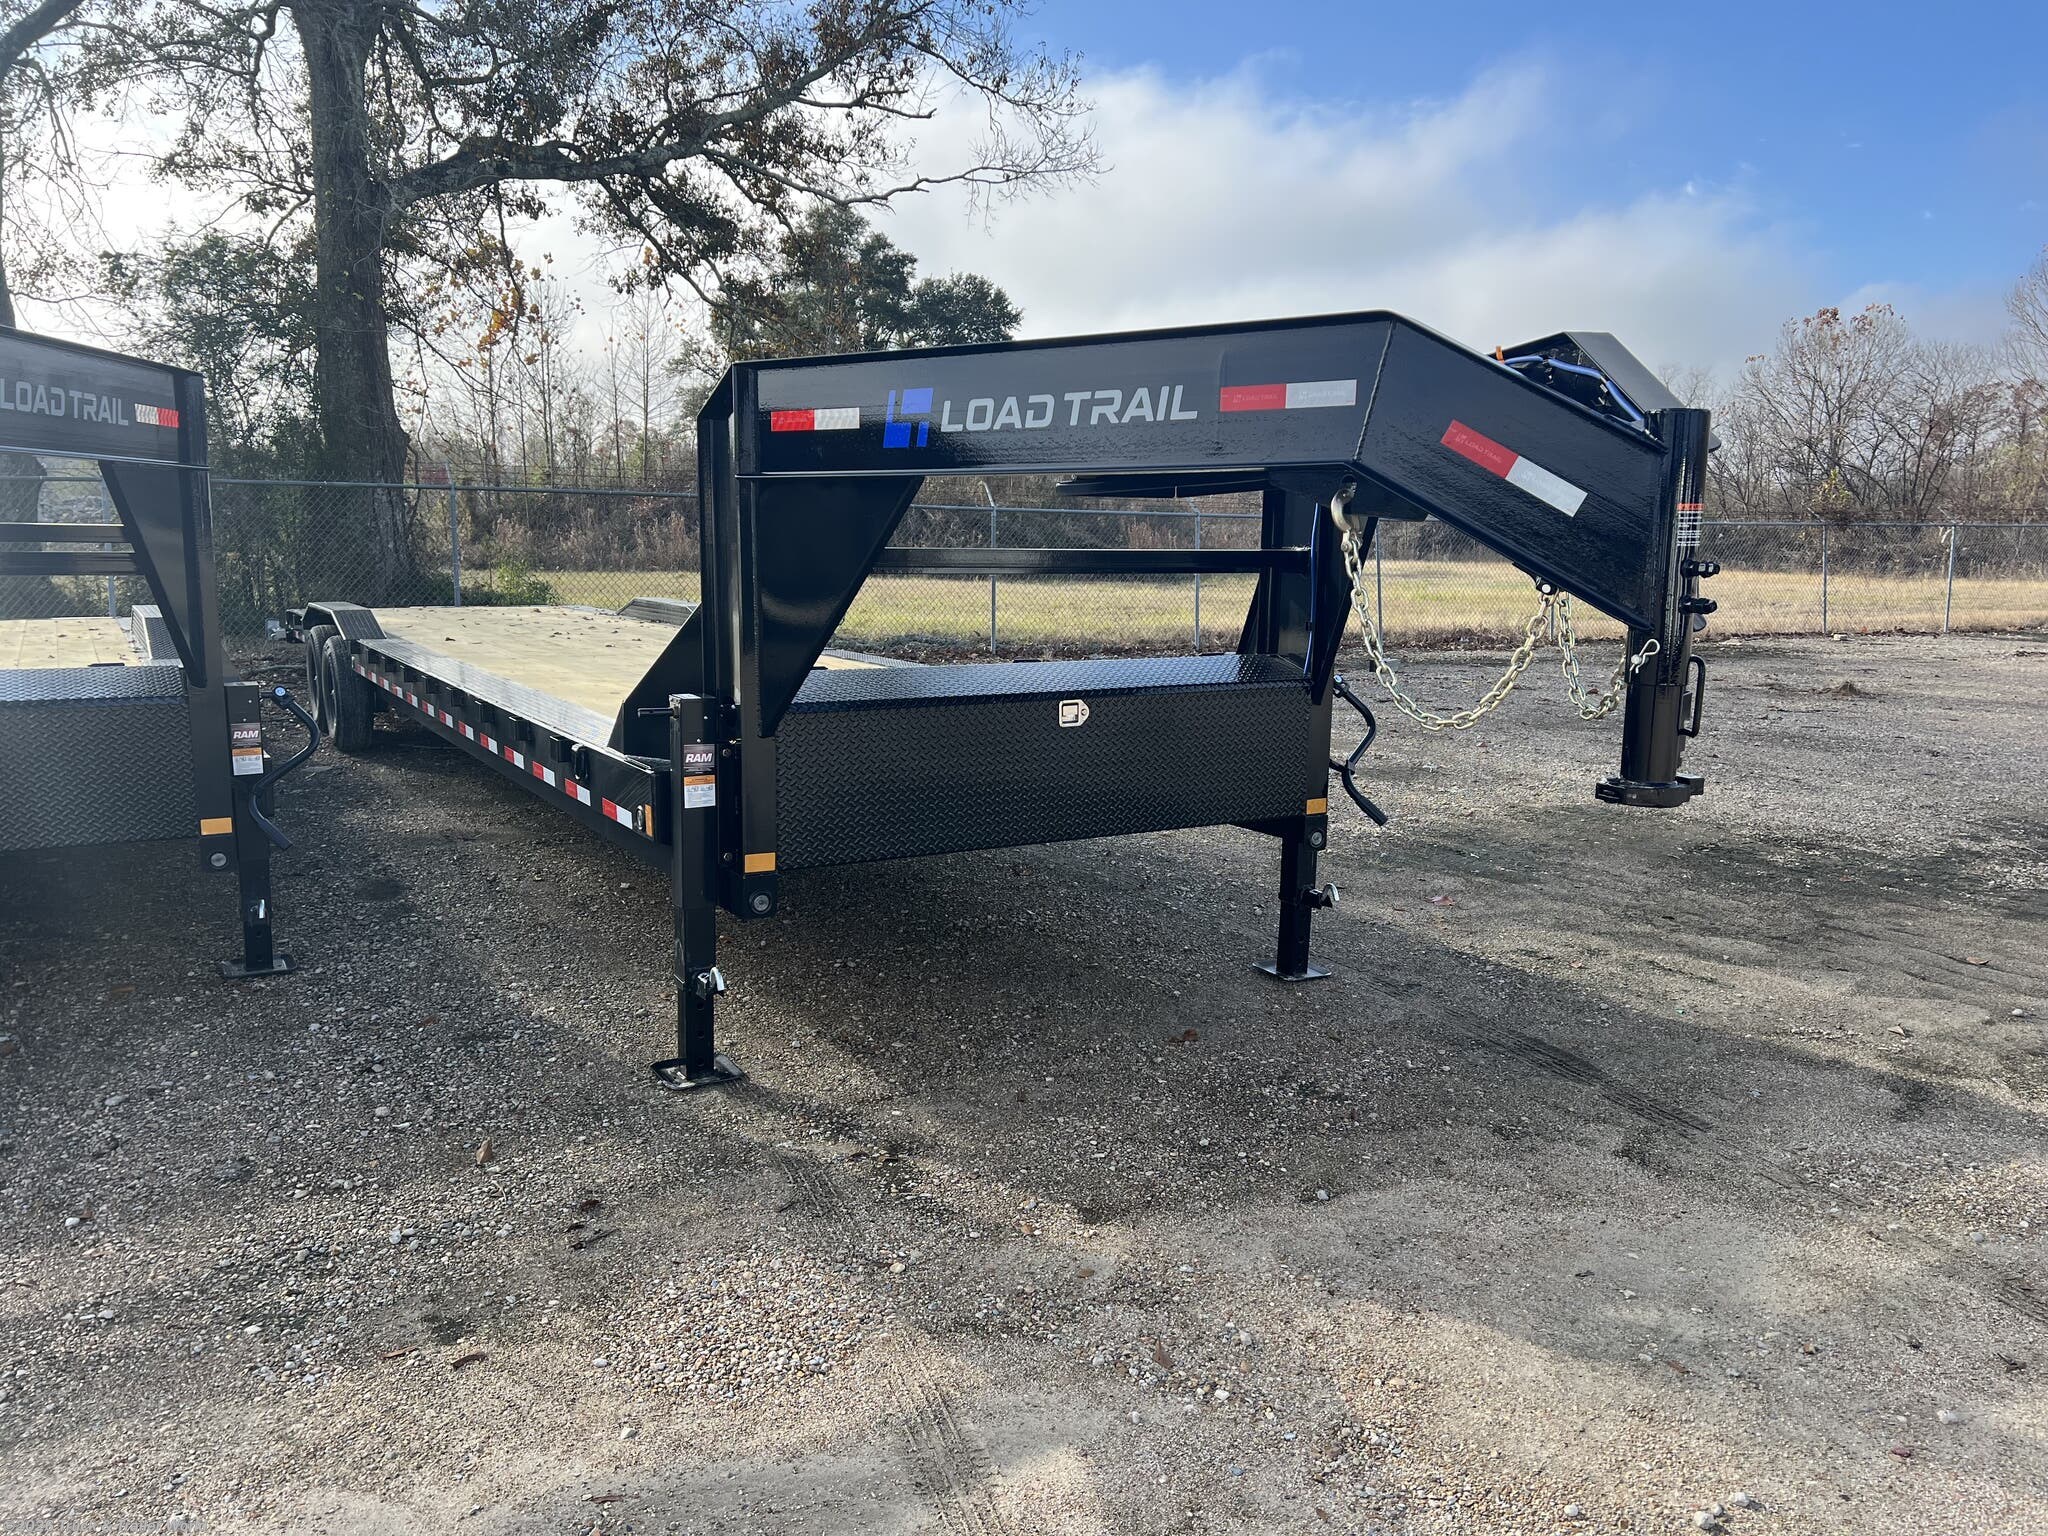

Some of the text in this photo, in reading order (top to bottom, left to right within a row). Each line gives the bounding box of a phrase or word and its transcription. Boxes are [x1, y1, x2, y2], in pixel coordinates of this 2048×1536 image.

[0, 378, 129, 426] LOAD TRAIL
[940, 384, 1198, 433] LOAD TRAIL
[233, 730, 259, 739] RAM
[685, 753, 713, 763] RAM
